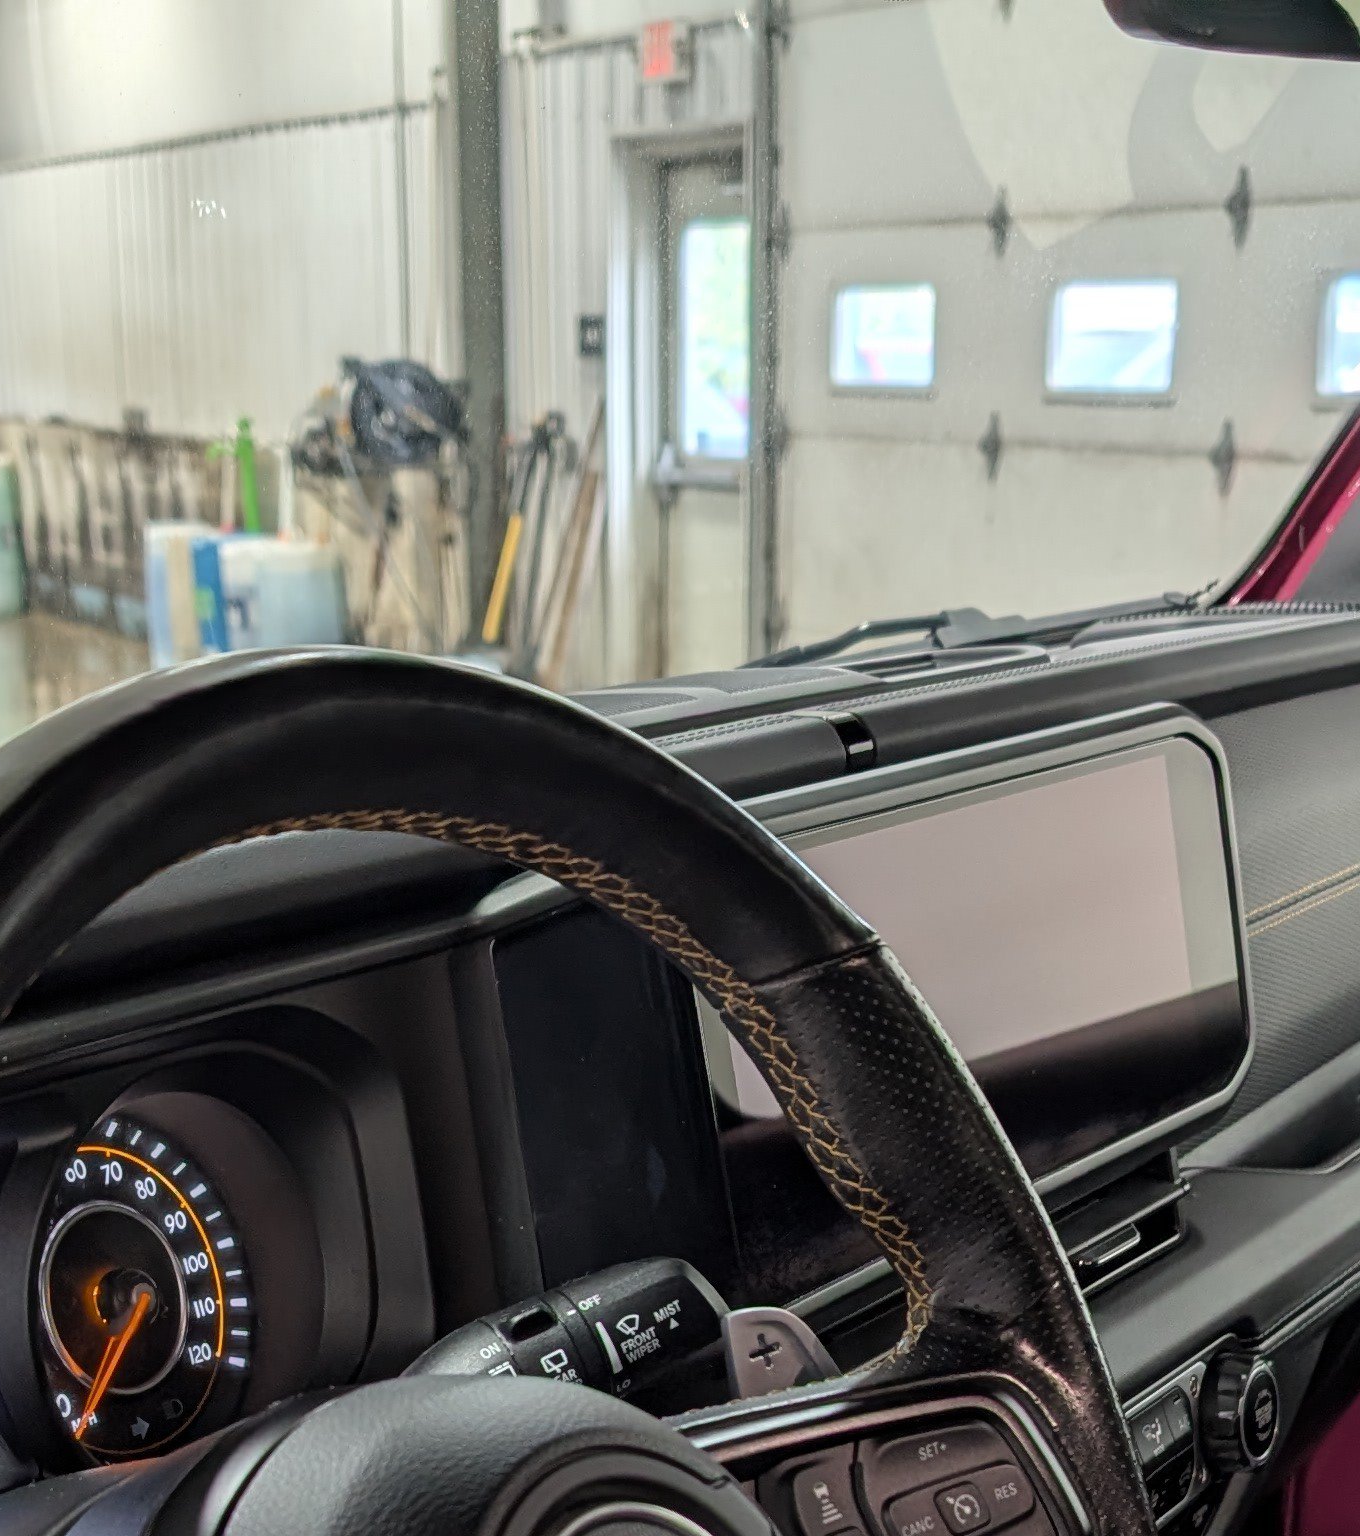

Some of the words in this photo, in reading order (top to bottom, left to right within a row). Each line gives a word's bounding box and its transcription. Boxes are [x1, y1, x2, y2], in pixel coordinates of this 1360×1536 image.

[100, 1161, 123, 1186] 70
[134, 1177, 157, 1200] 80
[164, 1210, 187, 1234] 90
[182, 1253, 209, 1276] 100
[192, 1297, 216, 1318] 110
[578, 1294, 602, 1312] OFF
[653, 1299, 683, 1325] MIST
[479, 1343, 502, 1360] ON
[619, 1326, 656, 1354] FRONT
[626, 1337, 662, 1364] WIPER
[187, 1343, 212, 1365] 120
[55, 1393, 72, 1418] 0
[994, 1482, 1019, 1501] RES
